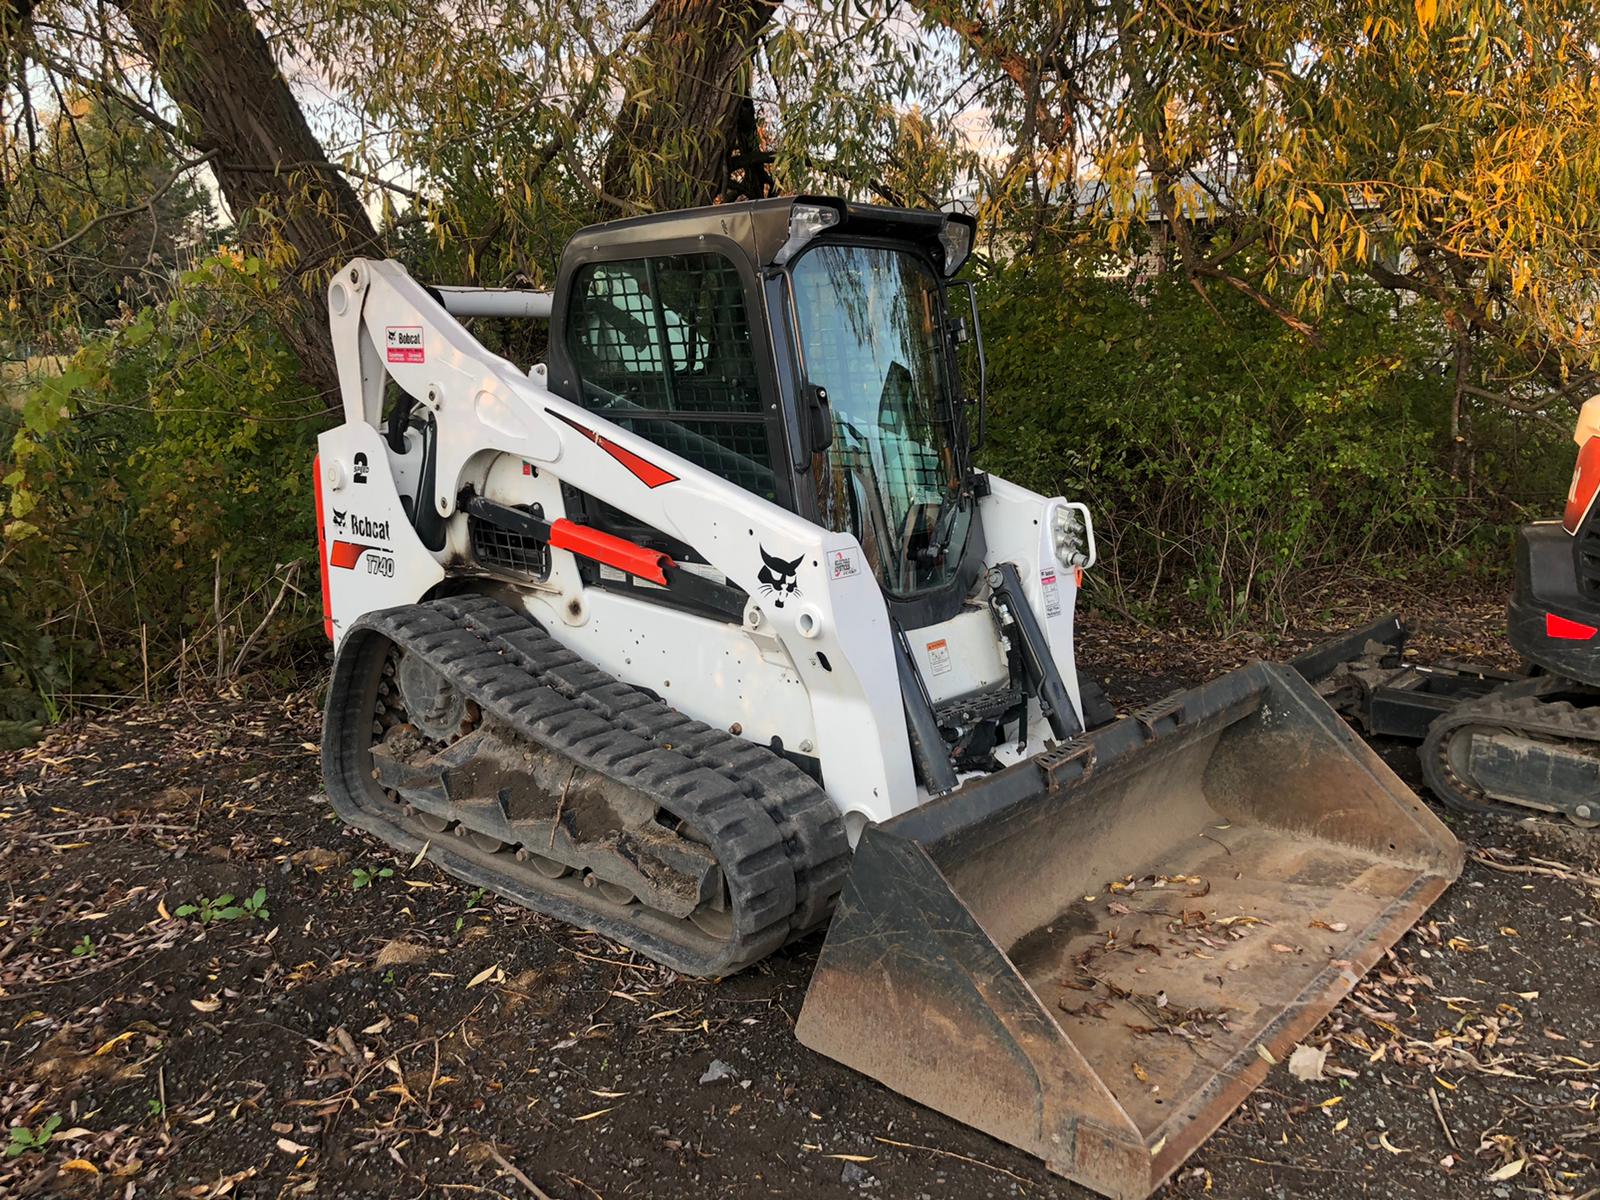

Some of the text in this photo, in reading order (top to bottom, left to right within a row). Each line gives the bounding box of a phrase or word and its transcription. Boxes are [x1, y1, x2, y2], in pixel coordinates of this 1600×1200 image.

[398, 332, 421, 345] Bobcat
[353, 452, 368, 484] 2
[350, 514, 391, 541] Bobcat
[366, 554, 395, 578] T740
